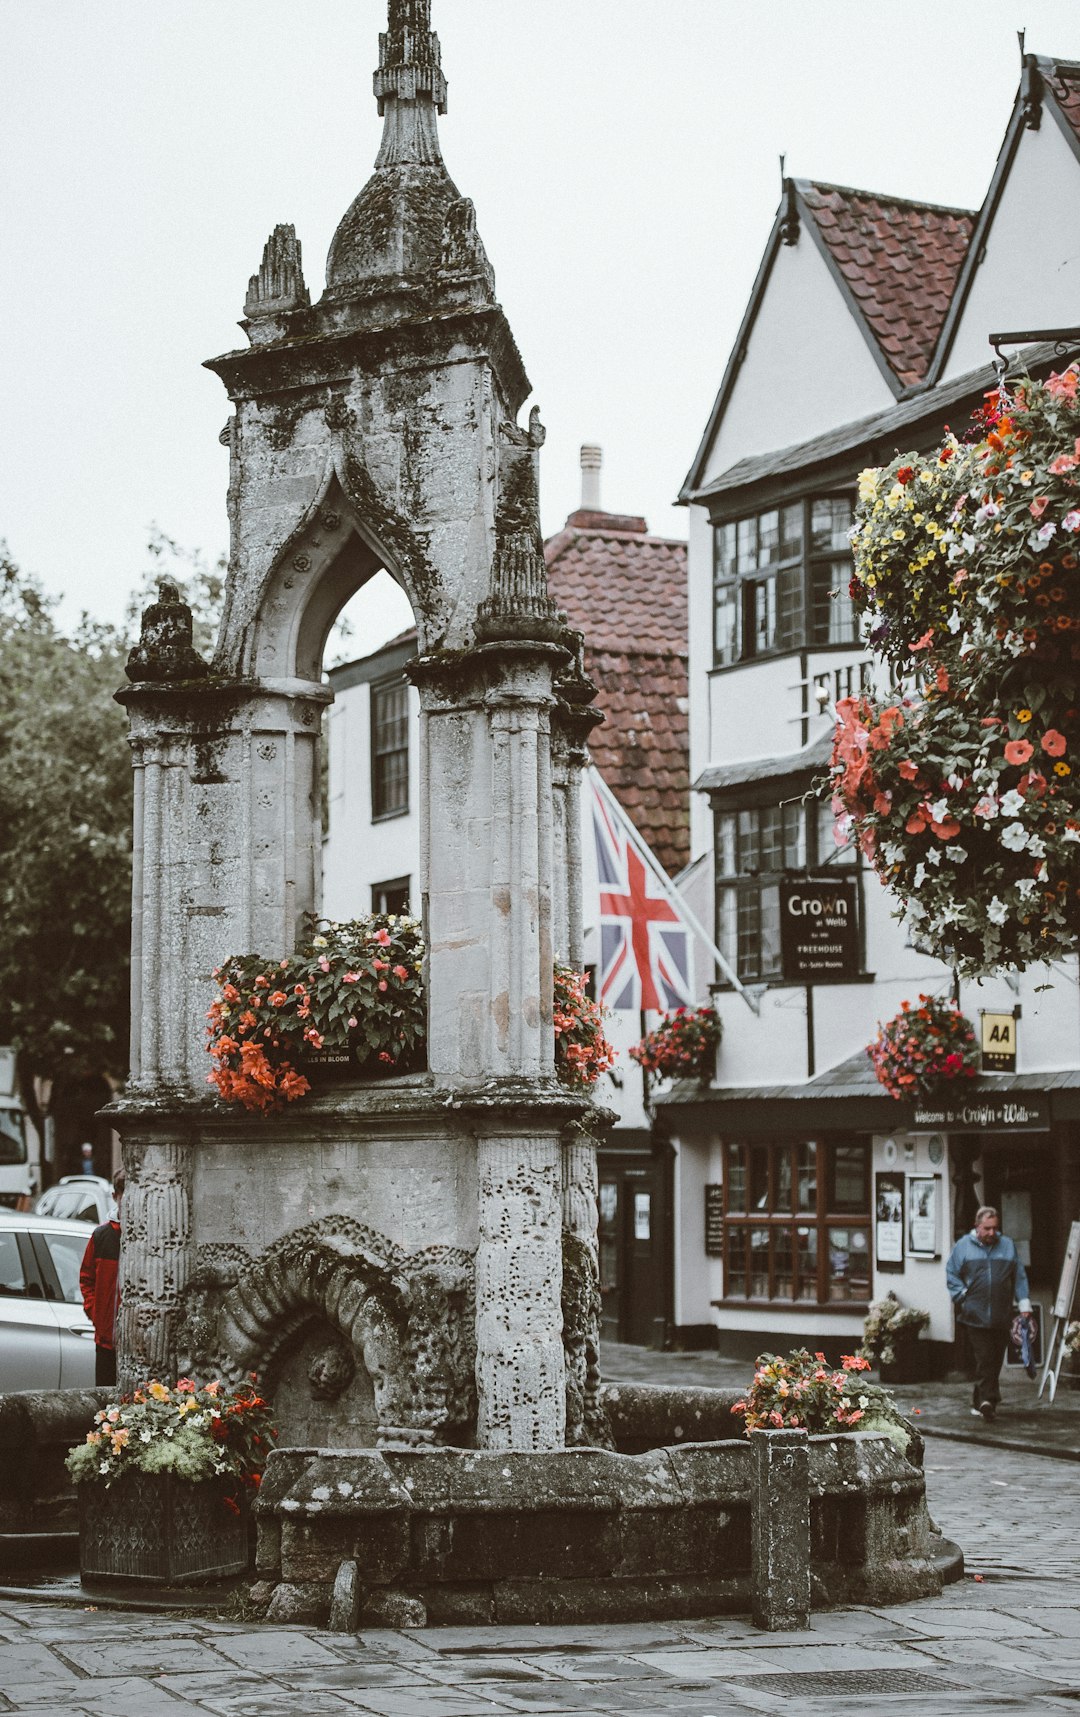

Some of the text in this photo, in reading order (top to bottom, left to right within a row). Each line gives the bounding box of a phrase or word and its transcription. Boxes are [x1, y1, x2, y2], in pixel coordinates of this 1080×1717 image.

[788, 894, 847, 916] Crown
[826, 918, 847, 927] Wells
[989, 1025, 1010, 1043] AA
[914, 1110, 945, 1123] Welcome
[946, 1111, 954, 1122] to
[962, 1104, 995, 1126] Crown
[1003, 1103, 1029, 1123] Wells
